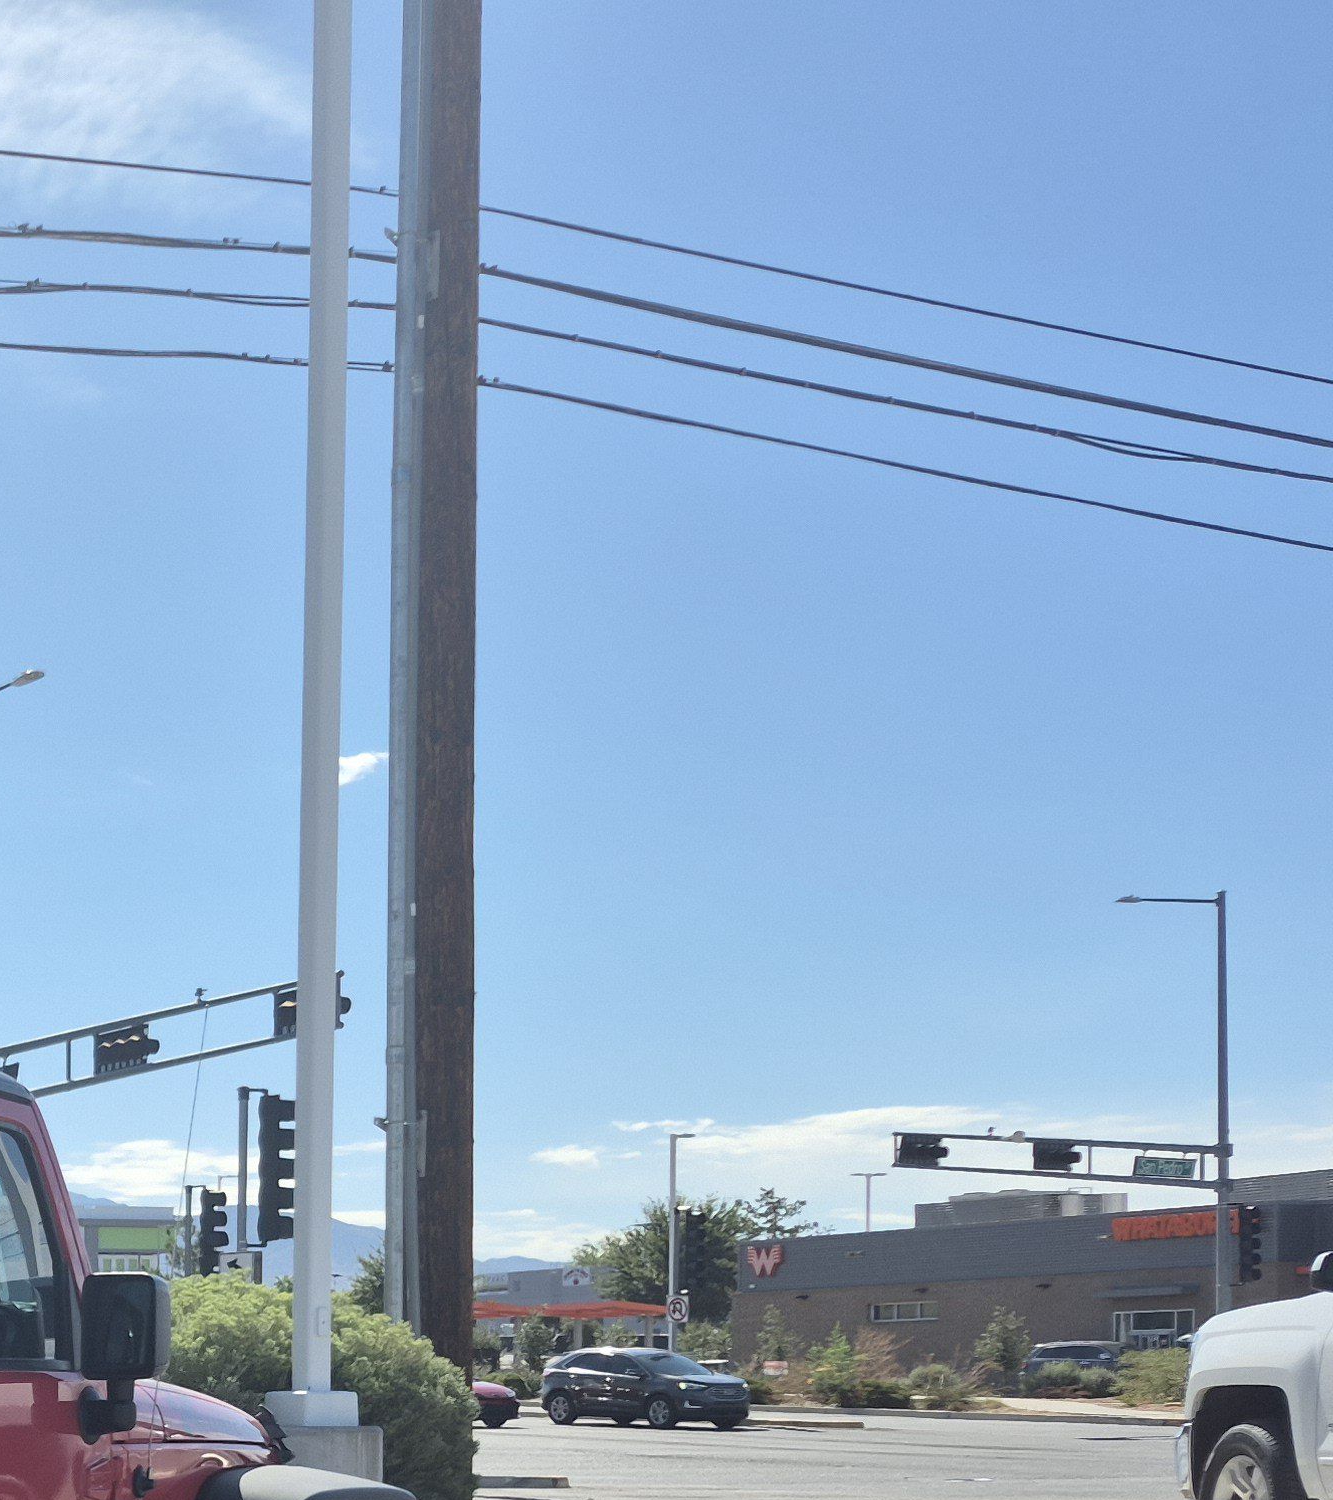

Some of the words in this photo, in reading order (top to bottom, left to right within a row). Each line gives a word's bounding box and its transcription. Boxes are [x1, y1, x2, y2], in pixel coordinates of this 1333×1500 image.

[1140, 1160, 1158, 1174] San
[1158, 1159, 1183, 1175] Pedro
[1112, 1208, 1241, 1241] WHATABUR
[747, 1244, 782, 1278] W
